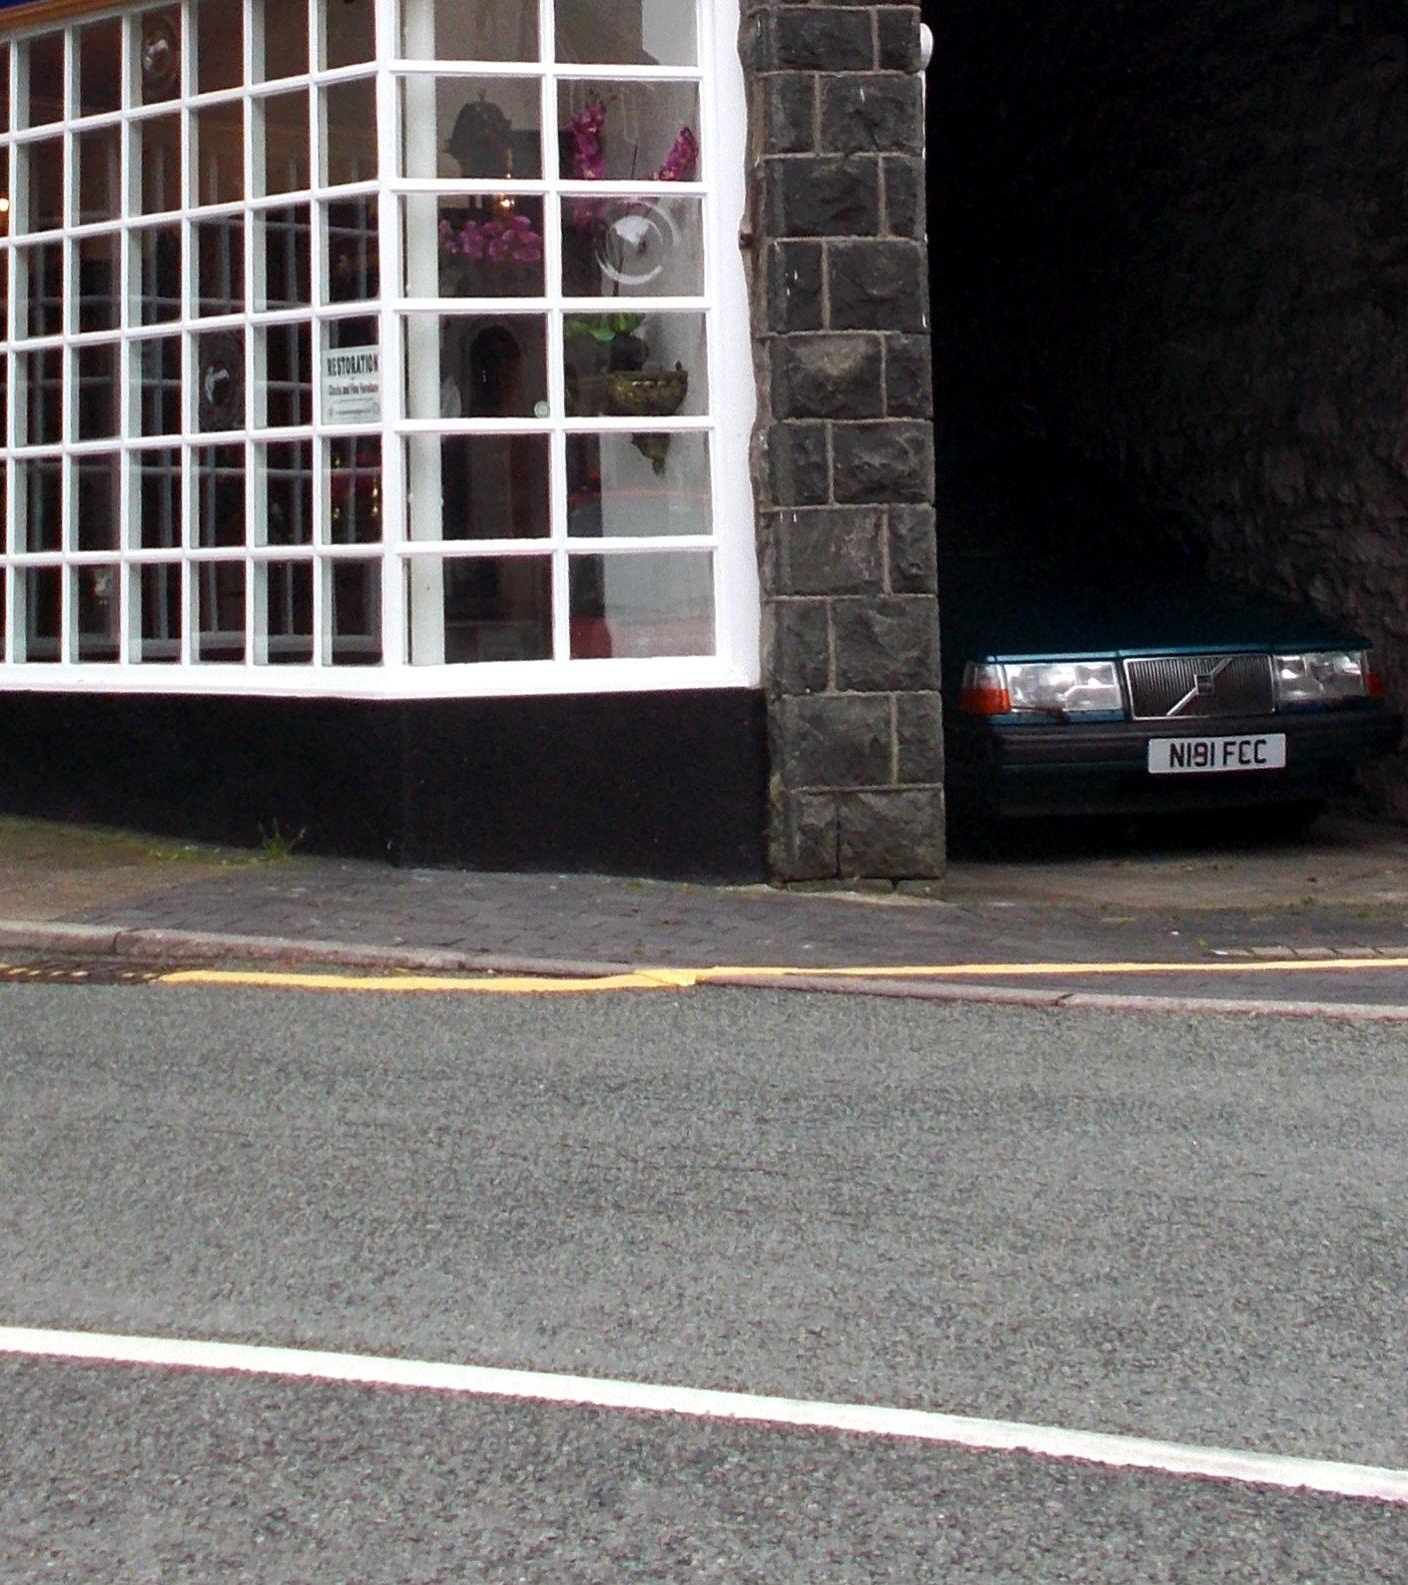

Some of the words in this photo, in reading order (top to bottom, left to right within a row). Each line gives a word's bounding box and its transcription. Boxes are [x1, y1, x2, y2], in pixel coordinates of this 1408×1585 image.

[327, 353, 379, 376] RESTORATION
[1169, 741, 1216, 768] N191
[1223, 738, 1268, 766] FCC
